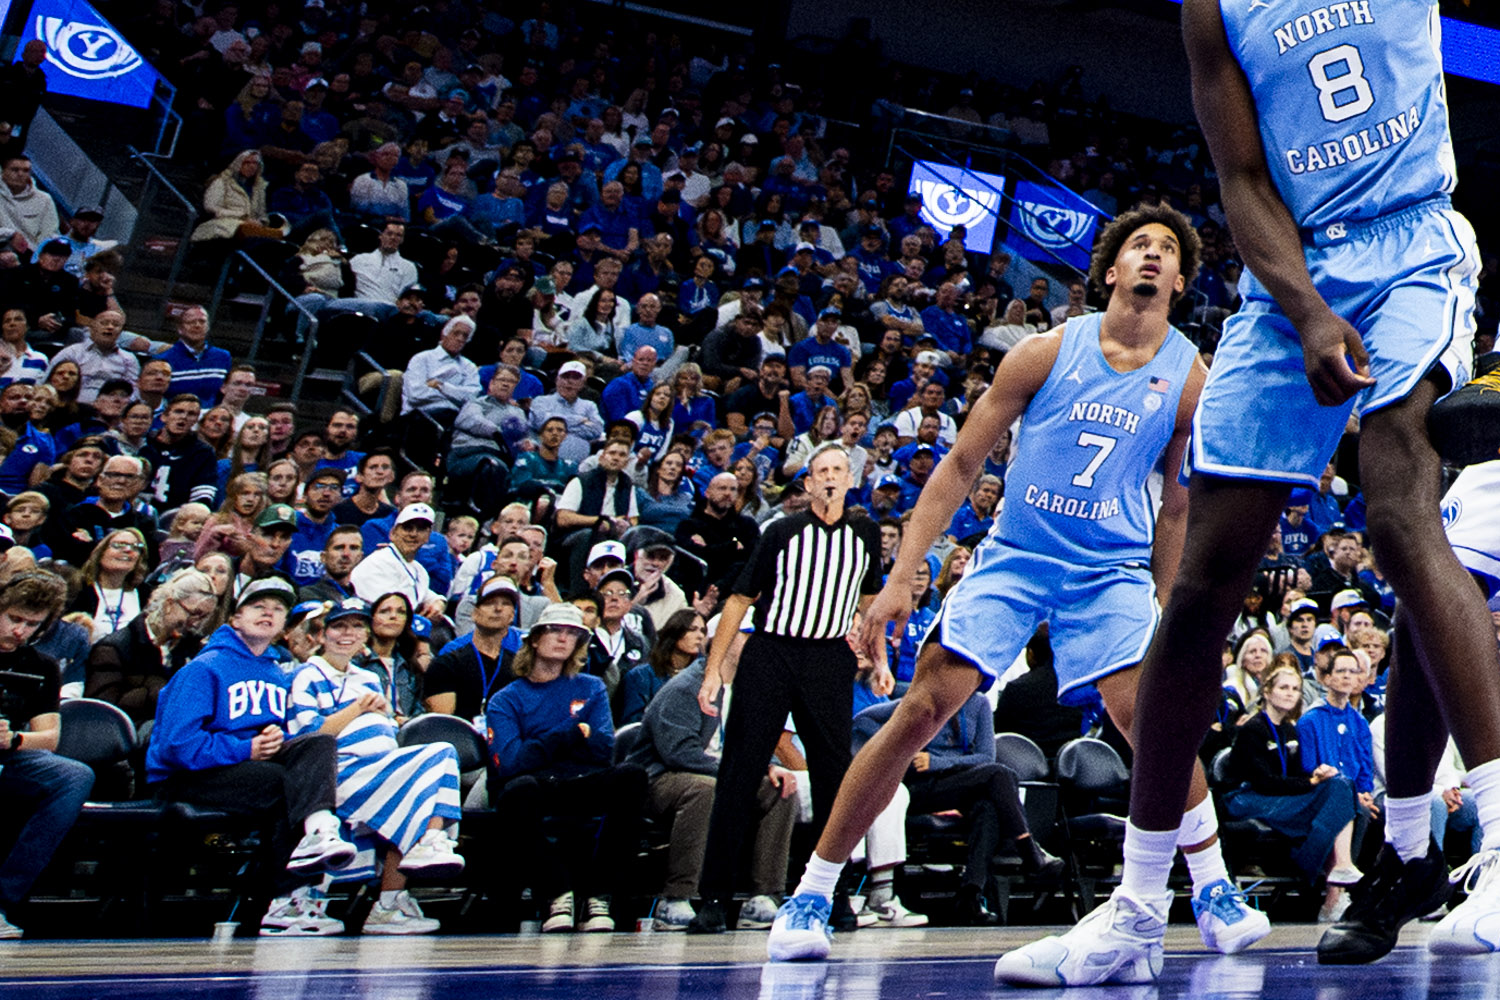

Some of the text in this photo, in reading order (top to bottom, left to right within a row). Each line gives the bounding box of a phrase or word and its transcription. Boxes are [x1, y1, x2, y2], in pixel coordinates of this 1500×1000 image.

[1273, 0, 1375, 56] NORTH
[1306, 43, 1375, 123] 8
[1286, 106, 1422, 175] CAROLINA
[1069, 402, 1141, 434] NORTH
[1072, 432, 1118, 489] 7
[1024, 484, 1120, 521] CAROLINA
[227, 680, 287, 720] BYU
